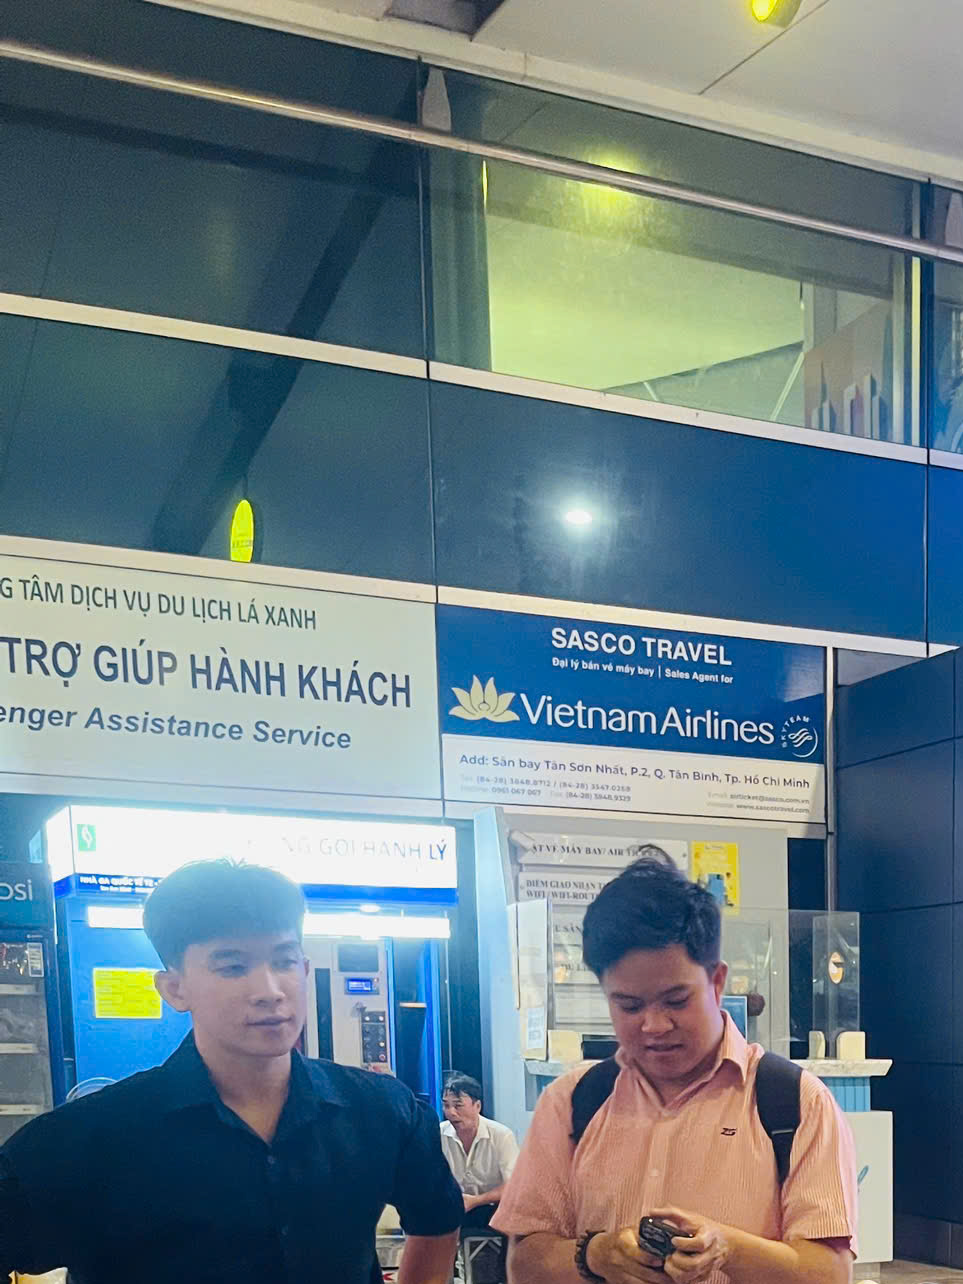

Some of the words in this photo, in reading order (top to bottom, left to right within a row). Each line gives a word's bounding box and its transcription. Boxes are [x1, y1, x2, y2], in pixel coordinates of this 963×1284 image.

[19, 574, 64, 603] TÂM
[71, 585, 118, 612] DỊCH
[123, 589, 151, 617] VỤ
[159, 593, 185, 616] DU
[192, 596, 231, 624] LỊCH
[238, 598, 260, 625] LÁ
[264, 604, 317, 630] XANH
[551, 627, 636, 656] SASCO
[641, 636, 733, 666] TRAVEL
[0, 636, 81, 688] TRỢ
[94, 638, 178, 687] GIÚP
[190, 647, 286, 697] HÀNH
[298, 660, 412, 708] KHÁCH
[552, 656, 568, 669] Đại
[570, 658, 580, 670] lý
[582, 659, 600, 672] bán
[602, 661, 614, 672] vé
[615, 663, 635, 676] máy
[637, 665, 654, 678] bay
[665, 668, 690, 680] Sales
[692, 671, 719, 684] Agent
[720, 673, 733, 684] for
[85, 707, 244, 741] Assistance
[252, 720, 352, 749] Service
[520, 692, 658, 734] Vietnam
[660, 706, 775, 745] Airlines
[459, 754, 489, 766] Add:
[519, 758, 541, 771] bay
[569, 762, 592, 773] Sơn
[630, 766, 651, 778] P.2,
[654, 768, 665, 779] Q.
[724, 773, 741, 785] Tp.
[783, 777, 810, 789] Minh
